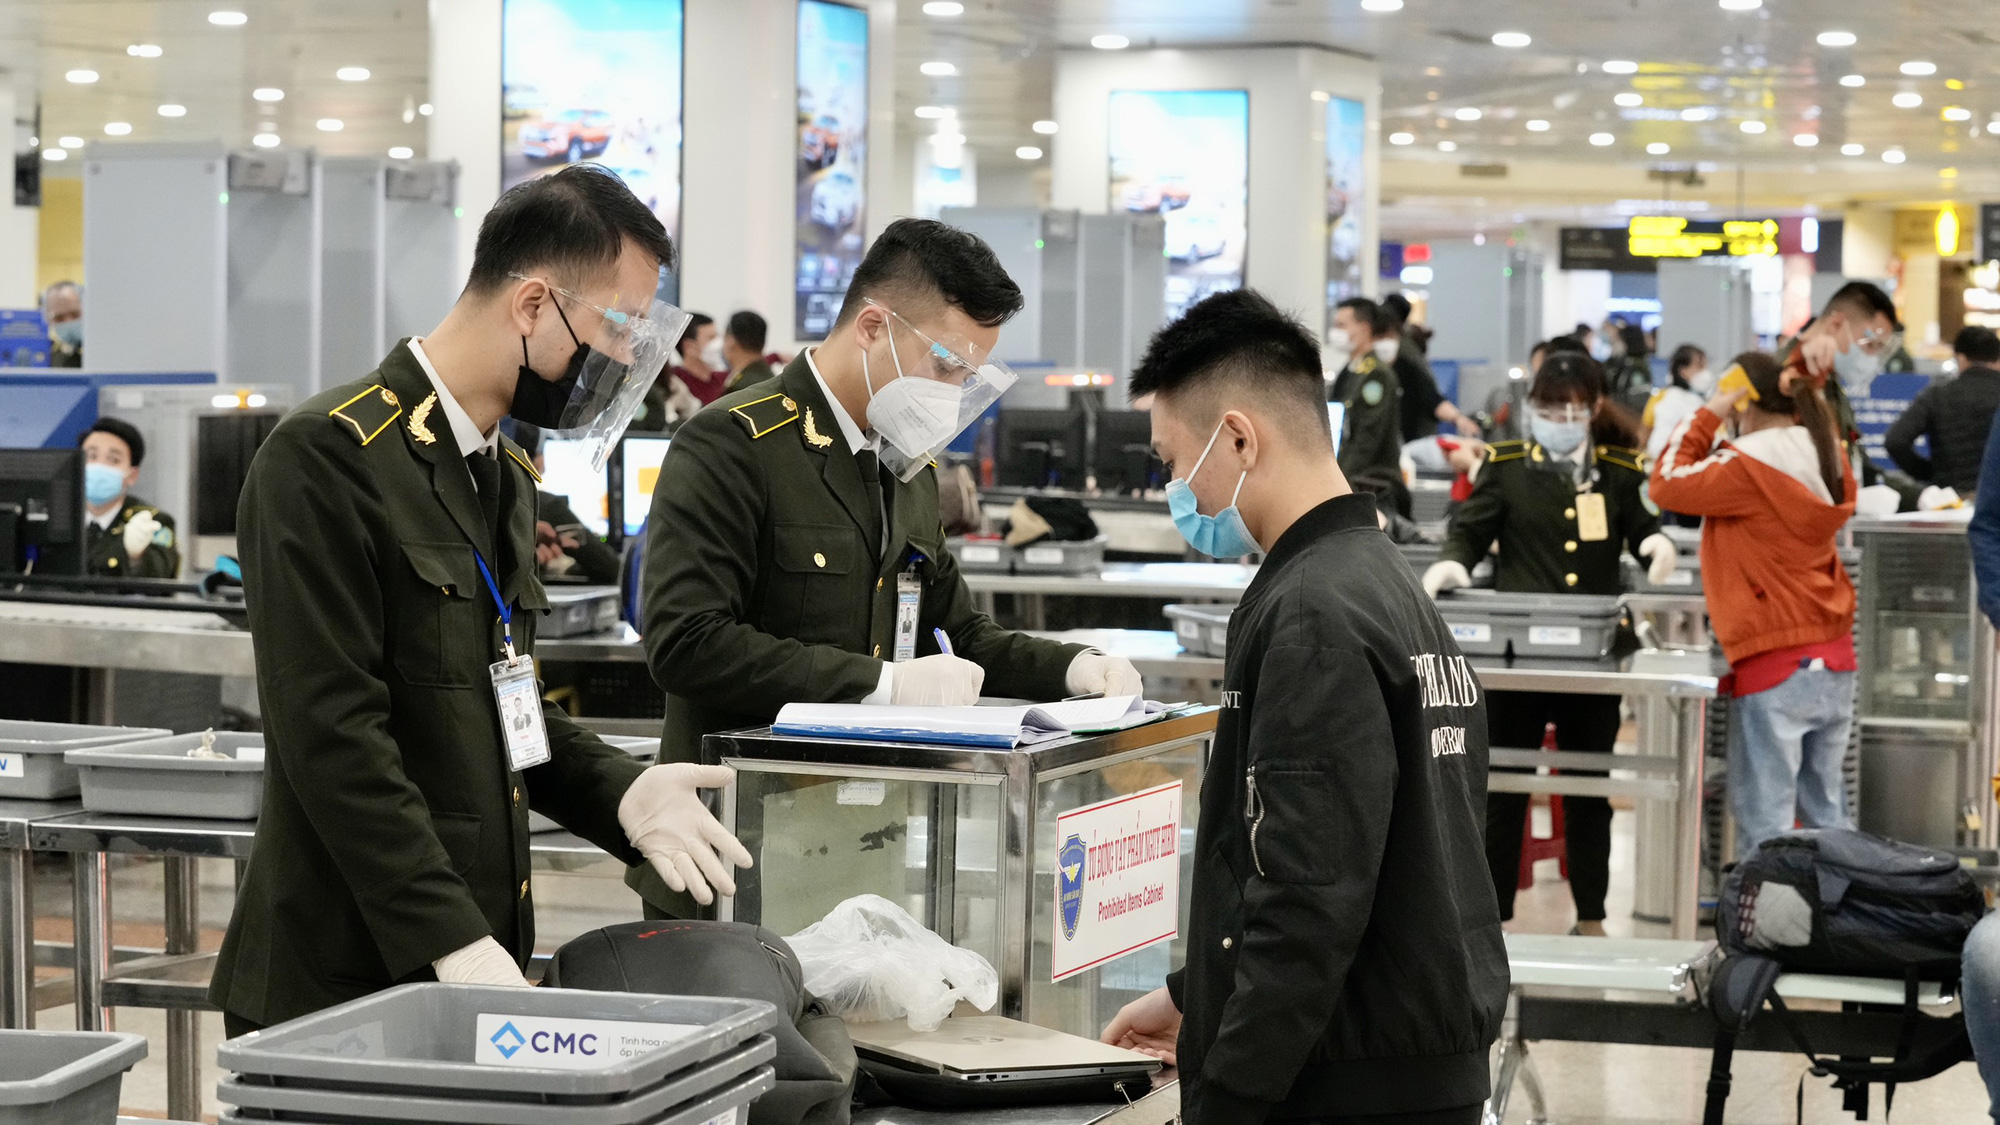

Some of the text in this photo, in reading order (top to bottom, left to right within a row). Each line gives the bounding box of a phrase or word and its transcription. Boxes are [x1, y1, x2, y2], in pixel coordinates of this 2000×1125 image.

[1098, 893, 1127, 922] Prohibited
[1127, 892, 1142, 912] Items
[1143, 882, 1164, 906] Cabinet
[531, 1031, 598, 1056] CMC
[620, 1036, 640, 1046] Tinh
[641, 1038, 660, 1047] hoa
